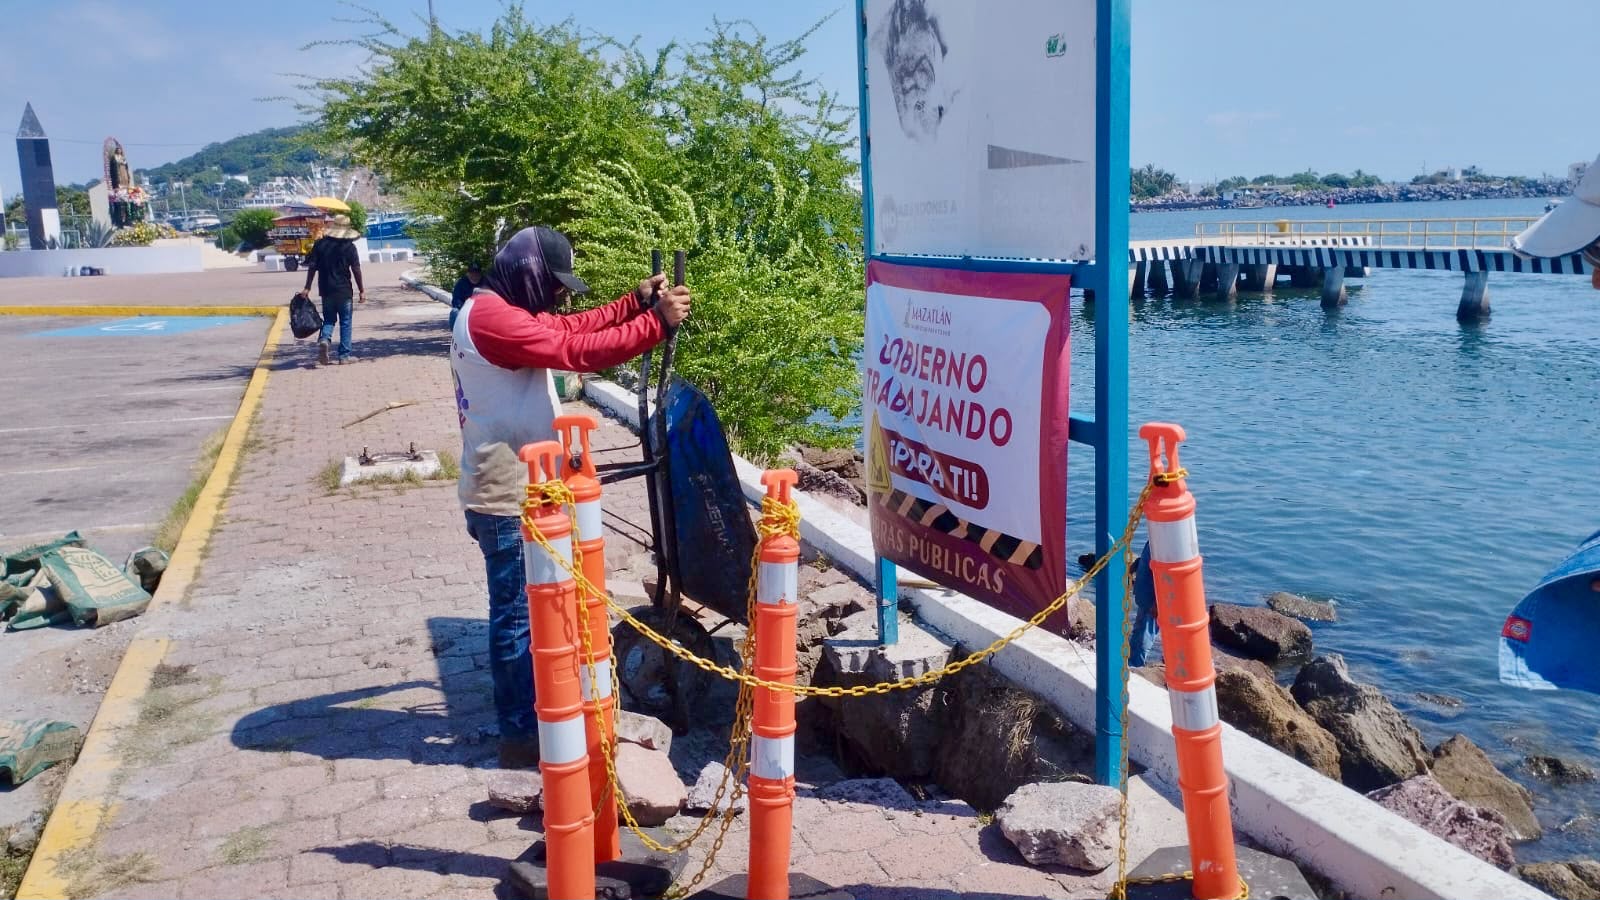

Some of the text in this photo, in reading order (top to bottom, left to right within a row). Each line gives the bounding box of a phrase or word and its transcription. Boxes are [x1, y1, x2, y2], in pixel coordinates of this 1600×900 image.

[912, 305, 952, 327] MAZATLÁN
[950, 465, 978, 501] TI!
[910, 532, 1007, 593] PÚBLICAS
